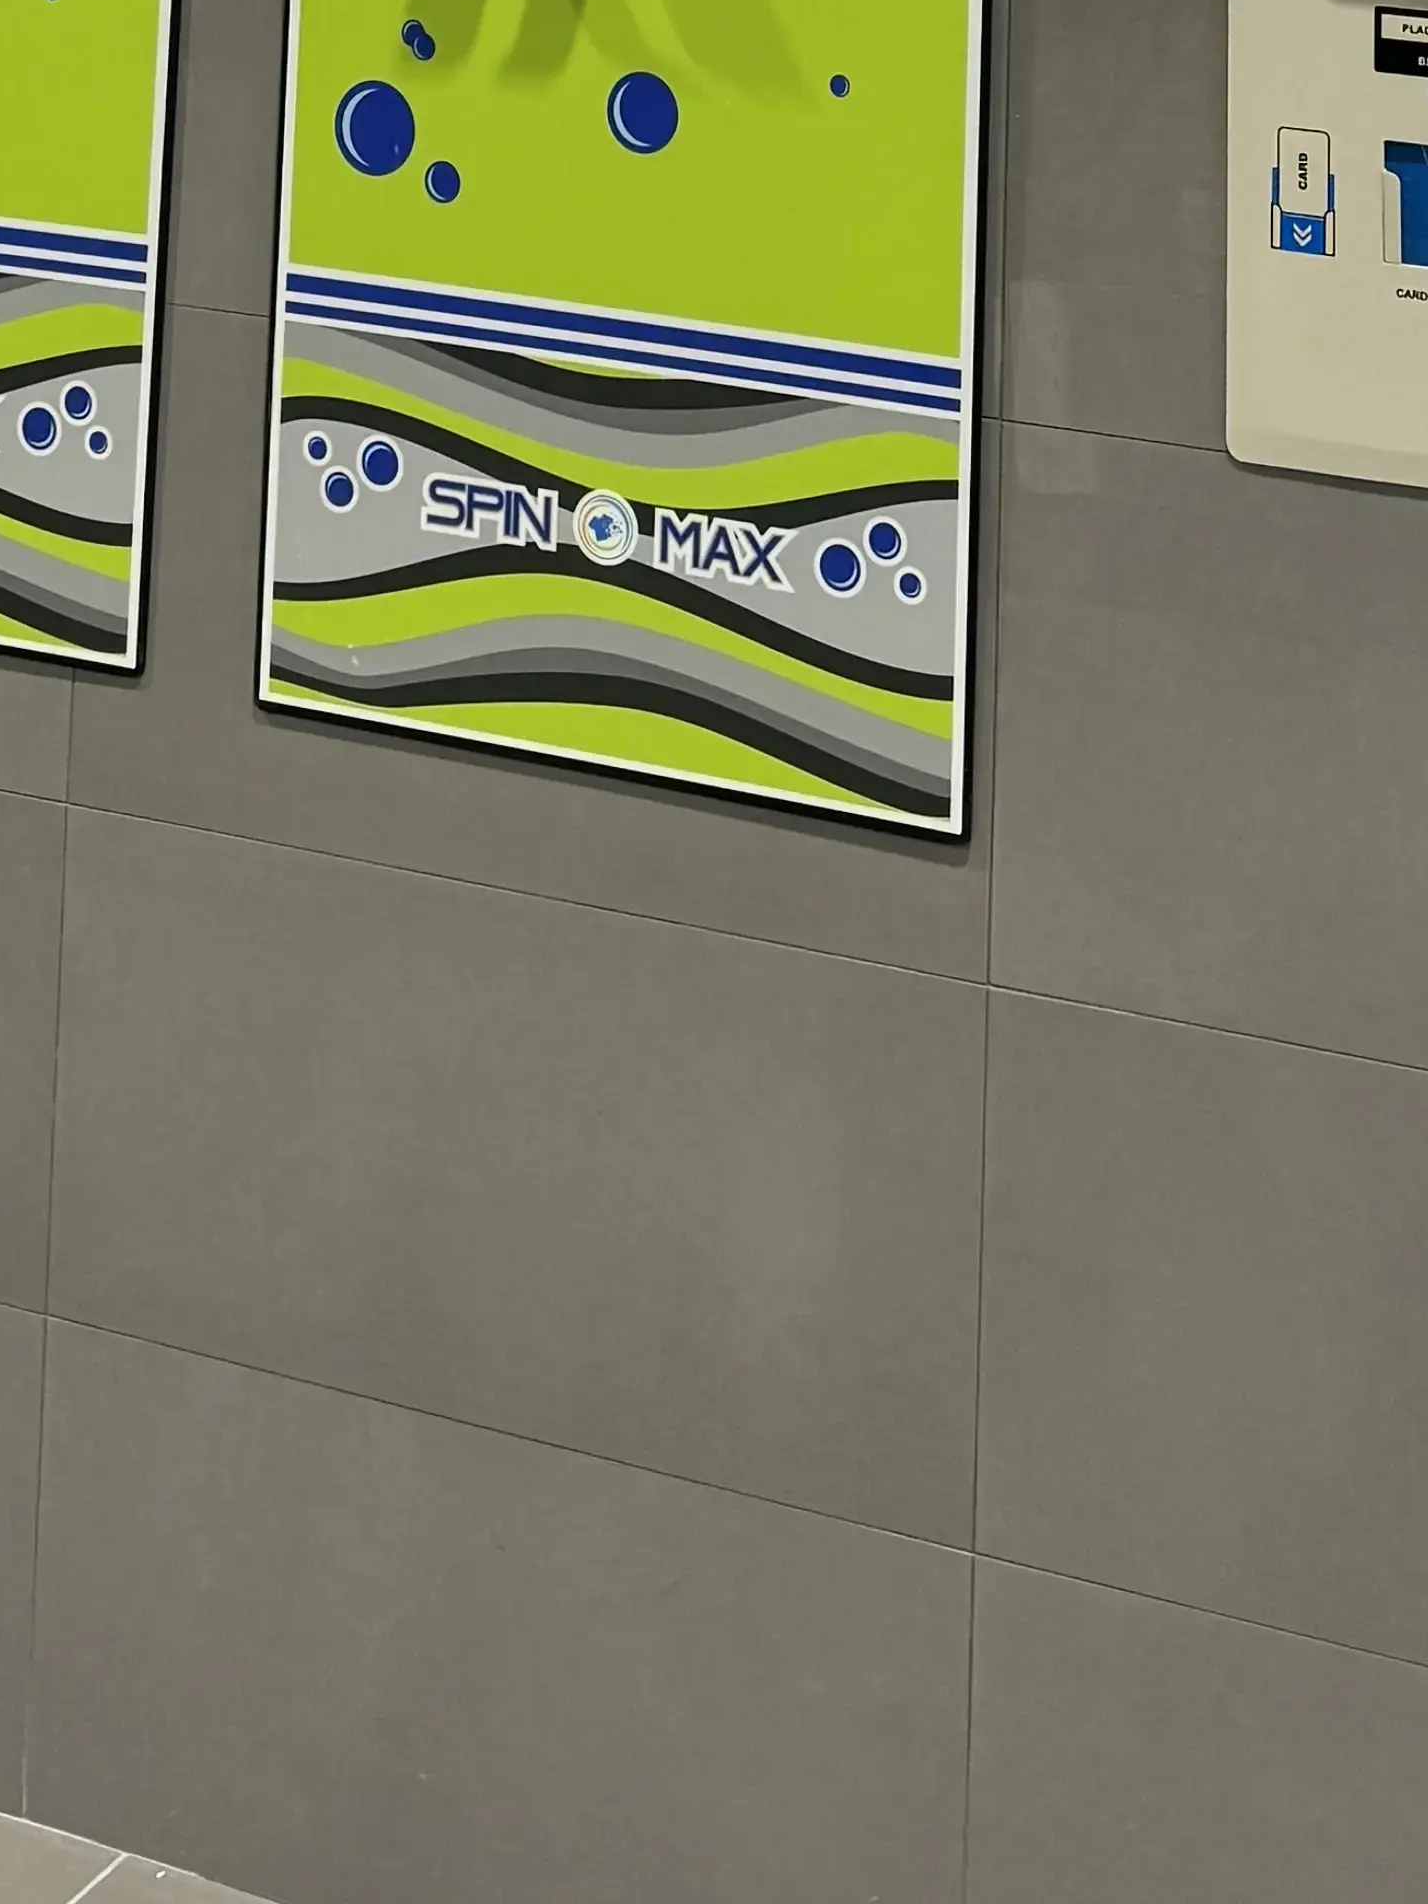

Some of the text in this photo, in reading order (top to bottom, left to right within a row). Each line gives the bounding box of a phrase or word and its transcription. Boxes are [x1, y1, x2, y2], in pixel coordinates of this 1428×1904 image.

[1297, 152, 1309, 191] CARD
[1396, 288, 1428, 302] CARD
[424, 478, 790, 590] SPIN MAX
